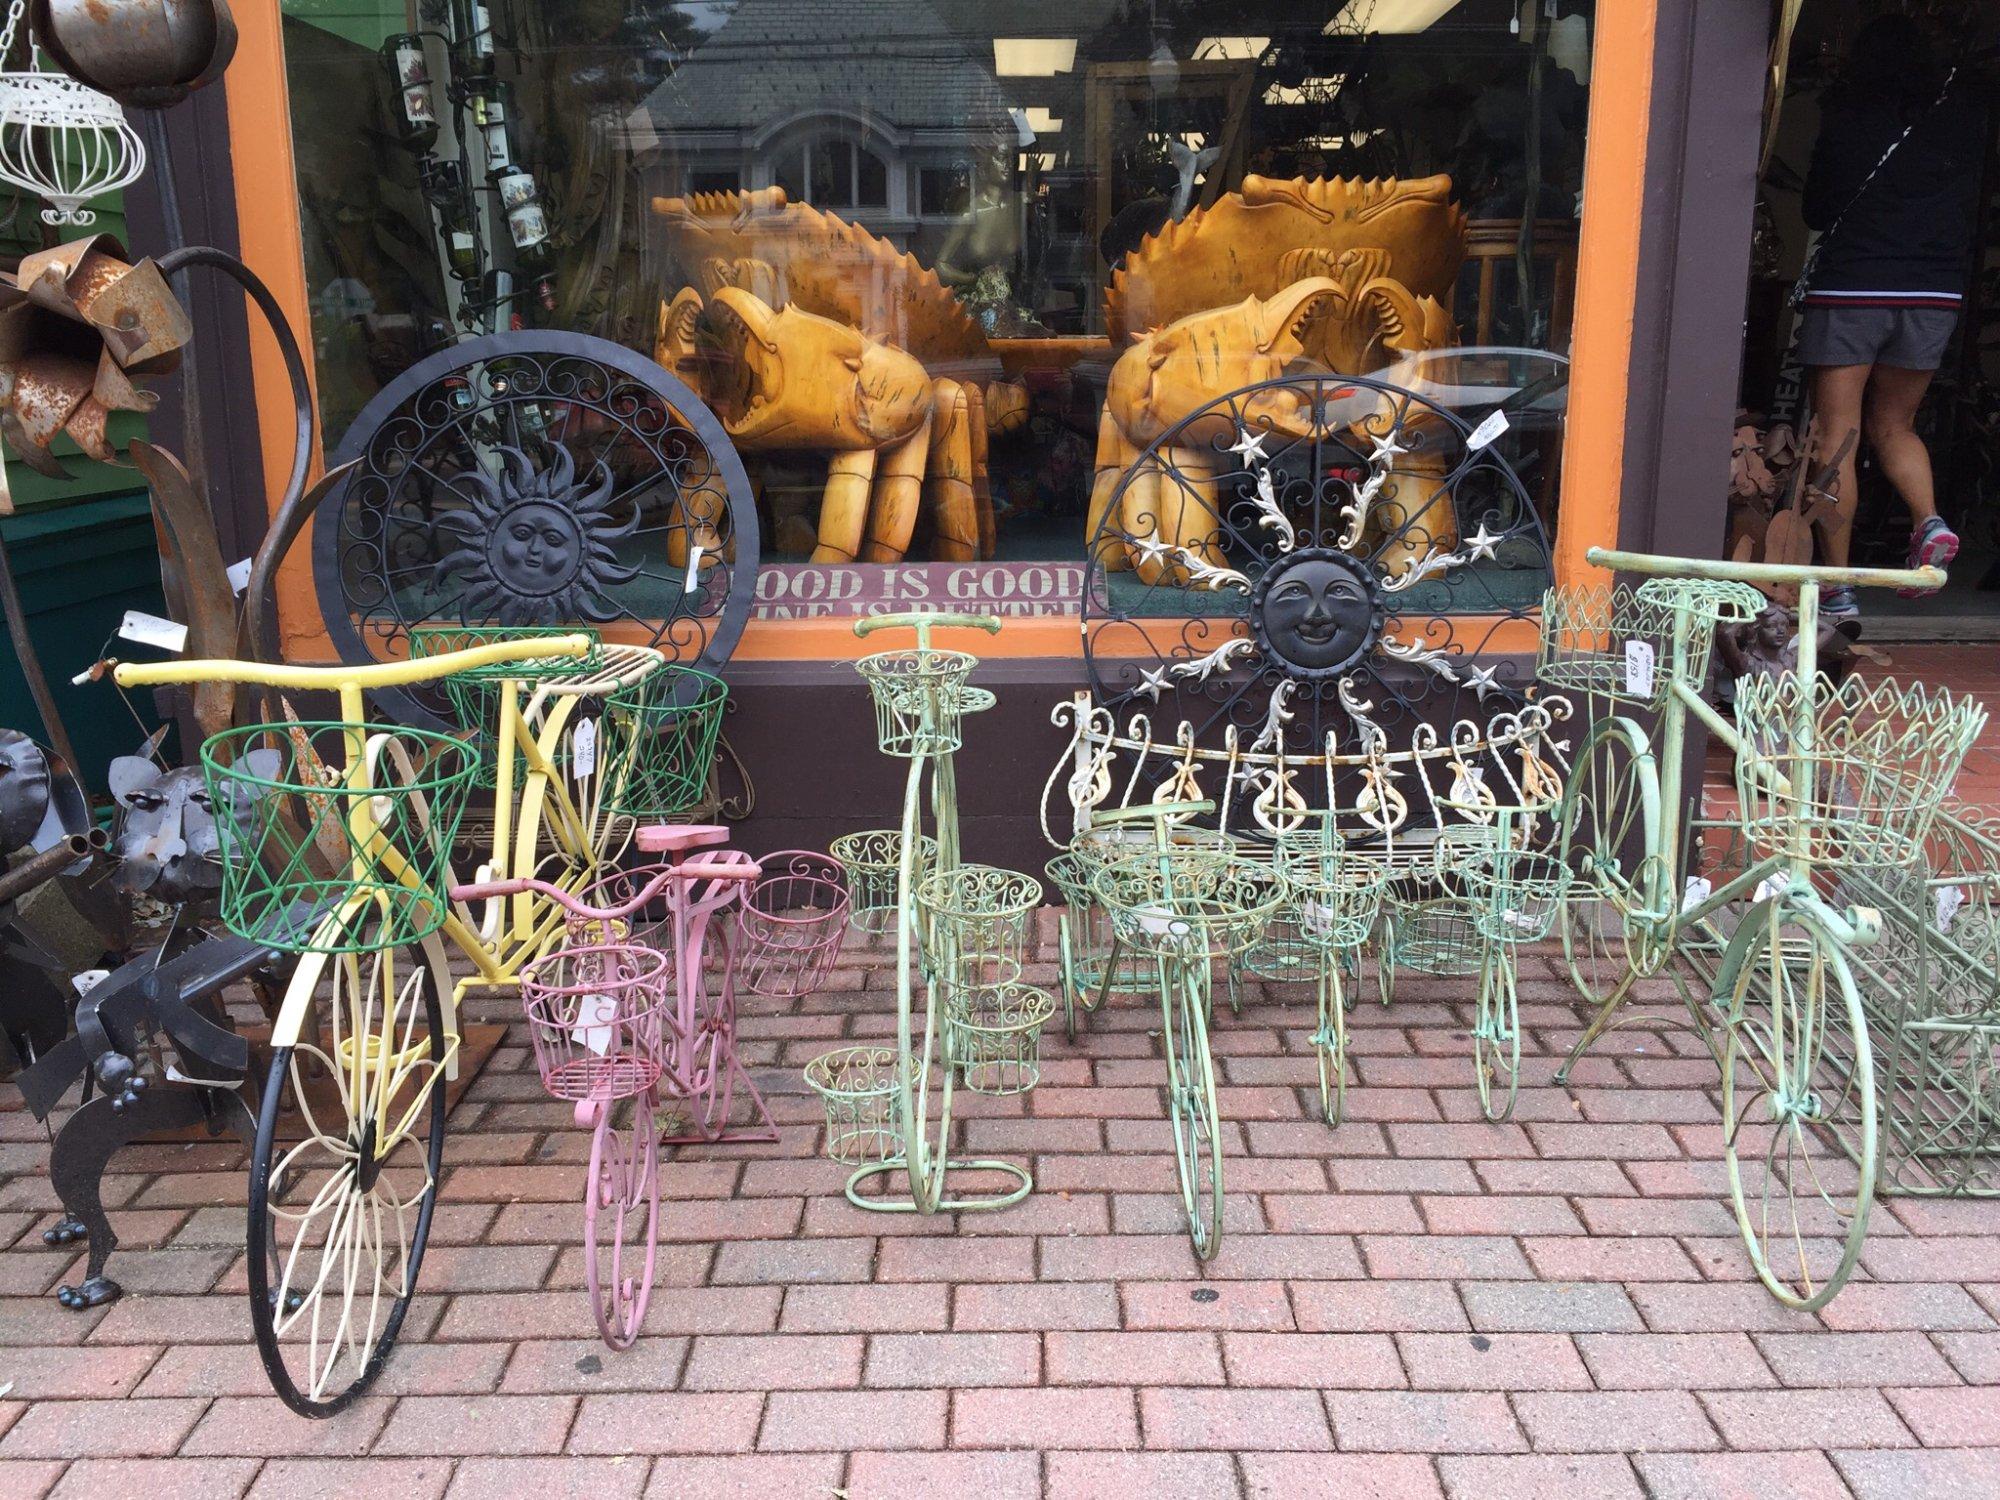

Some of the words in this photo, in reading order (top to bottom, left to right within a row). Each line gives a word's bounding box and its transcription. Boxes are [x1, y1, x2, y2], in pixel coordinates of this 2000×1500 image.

[728, 568, 863, 600] OOD
[880, 568, 930, 600] IS
[946, 567, 1086, 599] GOOD
[714, 601, 834, 619] INE
